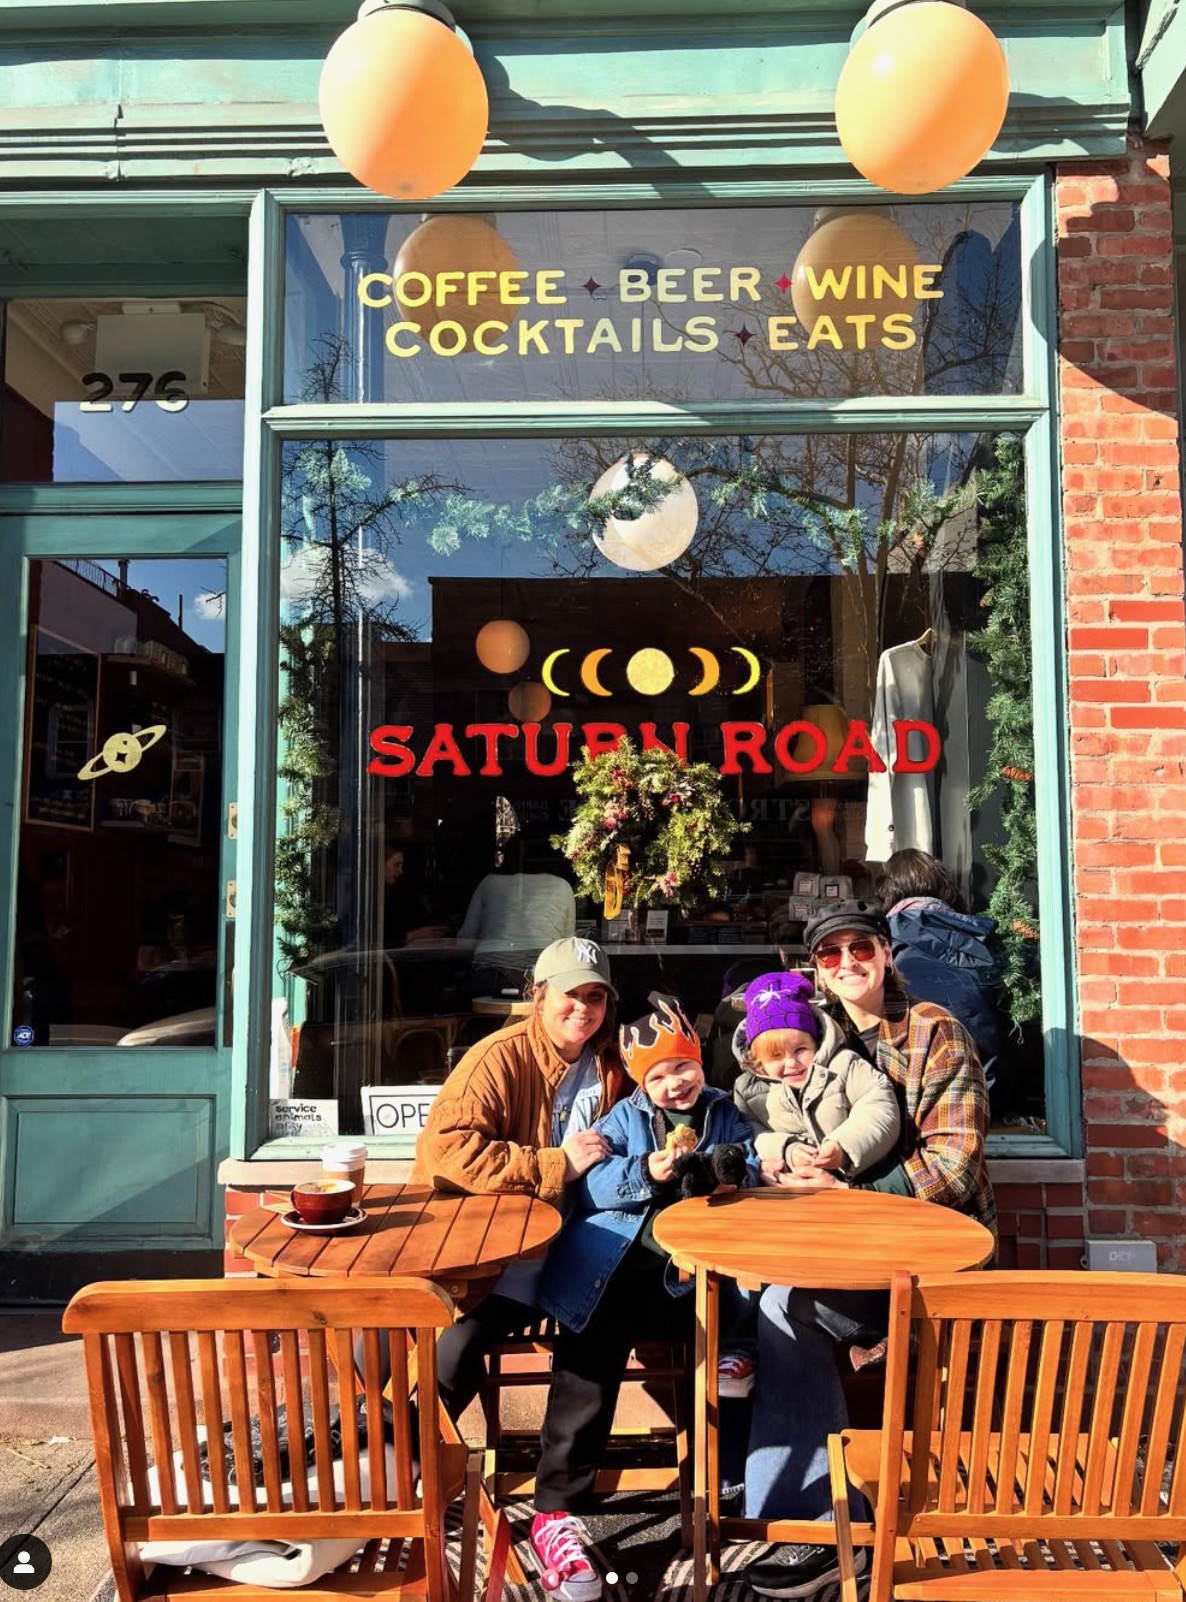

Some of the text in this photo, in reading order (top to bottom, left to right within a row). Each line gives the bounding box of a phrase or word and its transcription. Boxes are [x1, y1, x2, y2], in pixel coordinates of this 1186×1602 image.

[357, 263, 944, 309] COFFEE BEER WINE
[385, 312, 917, 357] COCKTAILS EATS
[80, 370, 189, 413] 276
[720, 720, 941, 774] ROAD
[577, 944, 598, 964] NY
[275, 1103, 317, 1113] service
[275, 1113, 322, 1122] animals
[376, 1103, 430, 1128] OPE
